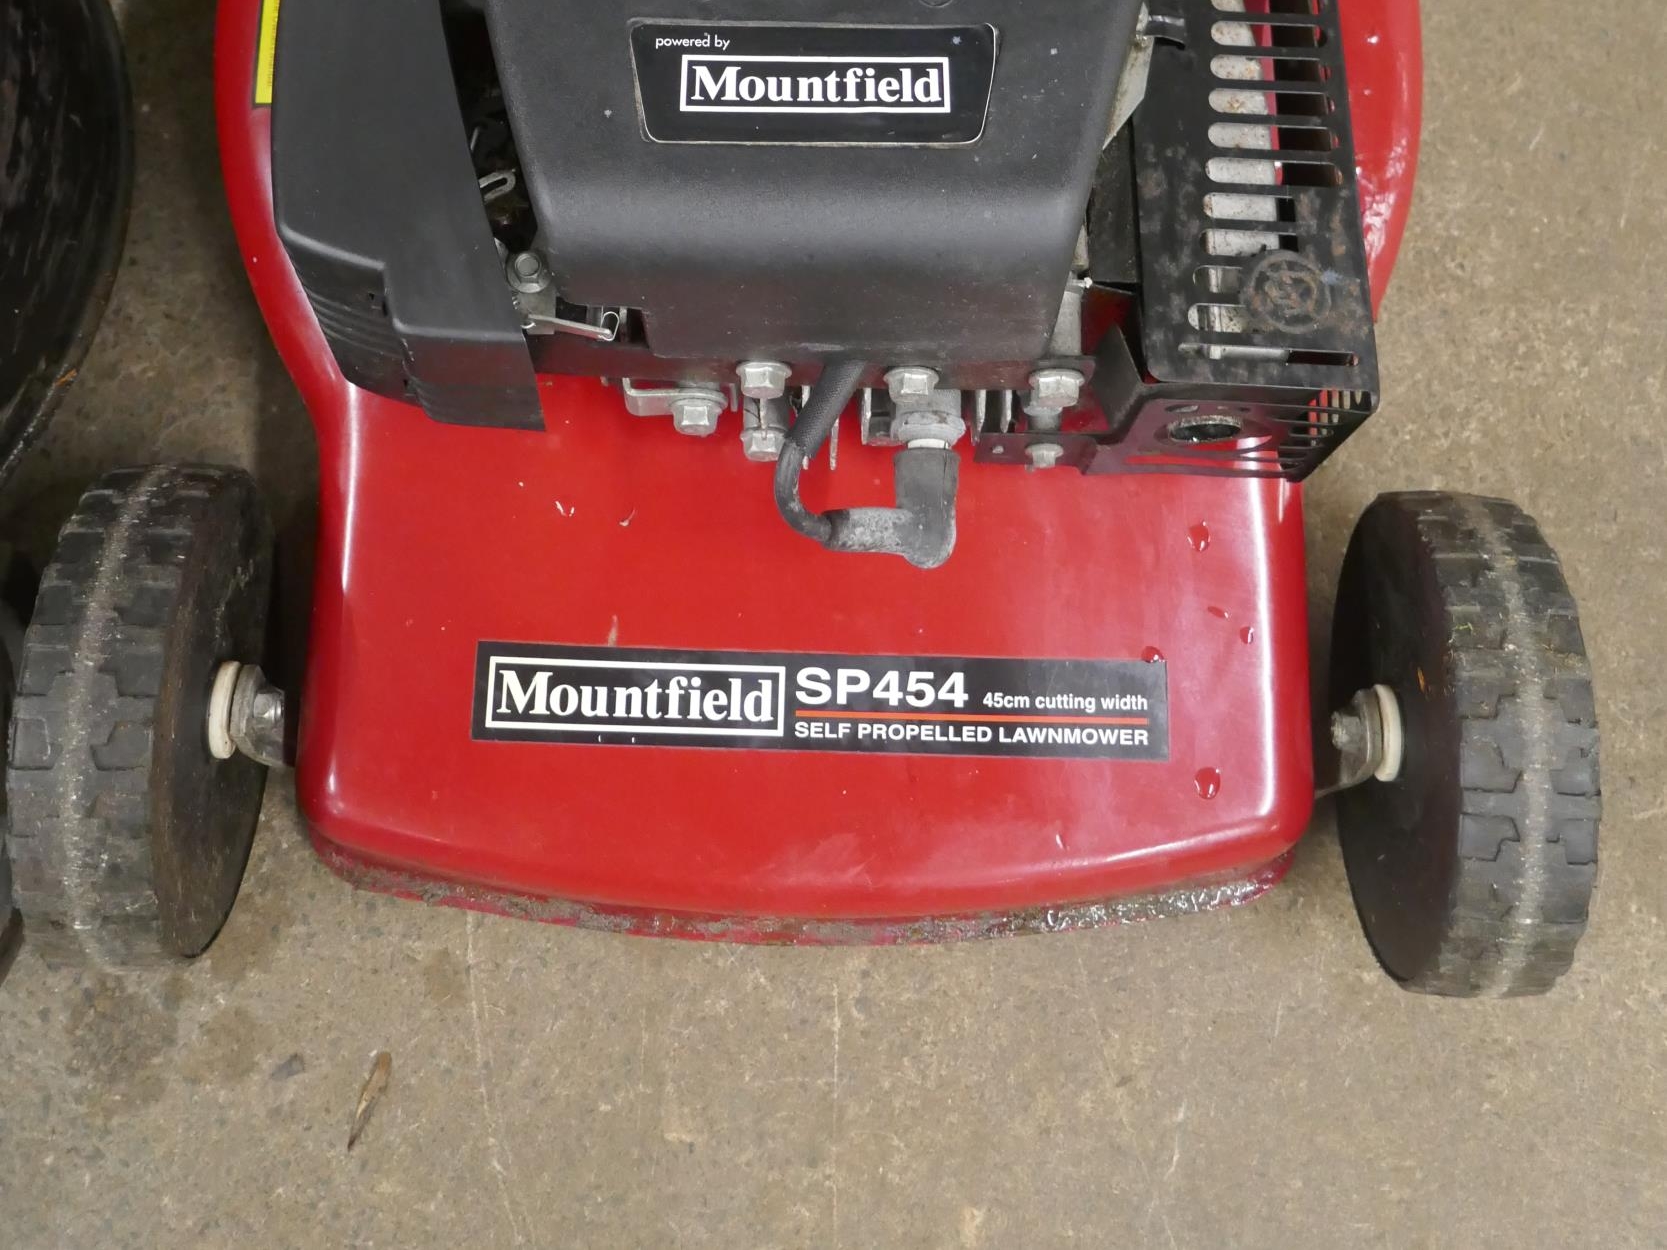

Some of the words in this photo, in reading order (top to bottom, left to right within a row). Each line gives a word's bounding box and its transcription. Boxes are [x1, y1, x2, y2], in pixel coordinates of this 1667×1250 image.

[655, 34, 711, 49] powered
[714, 35, 731, 50] by
[690, 64, 943, 103] Mountfield
[496, 669, 774, 722] Mountfield
[795, 666, 969, 708] SP454
[982, 691, 1030, 709] 45cm
[1034, 692, 1096, 714] cutting
[1100, 694, 1148, 711] width
[794, 721, 851, 739] SELF
[857, 723, 993, 743] PROPELLED
[998, 726, 1149, 746] LAWNMOWER
